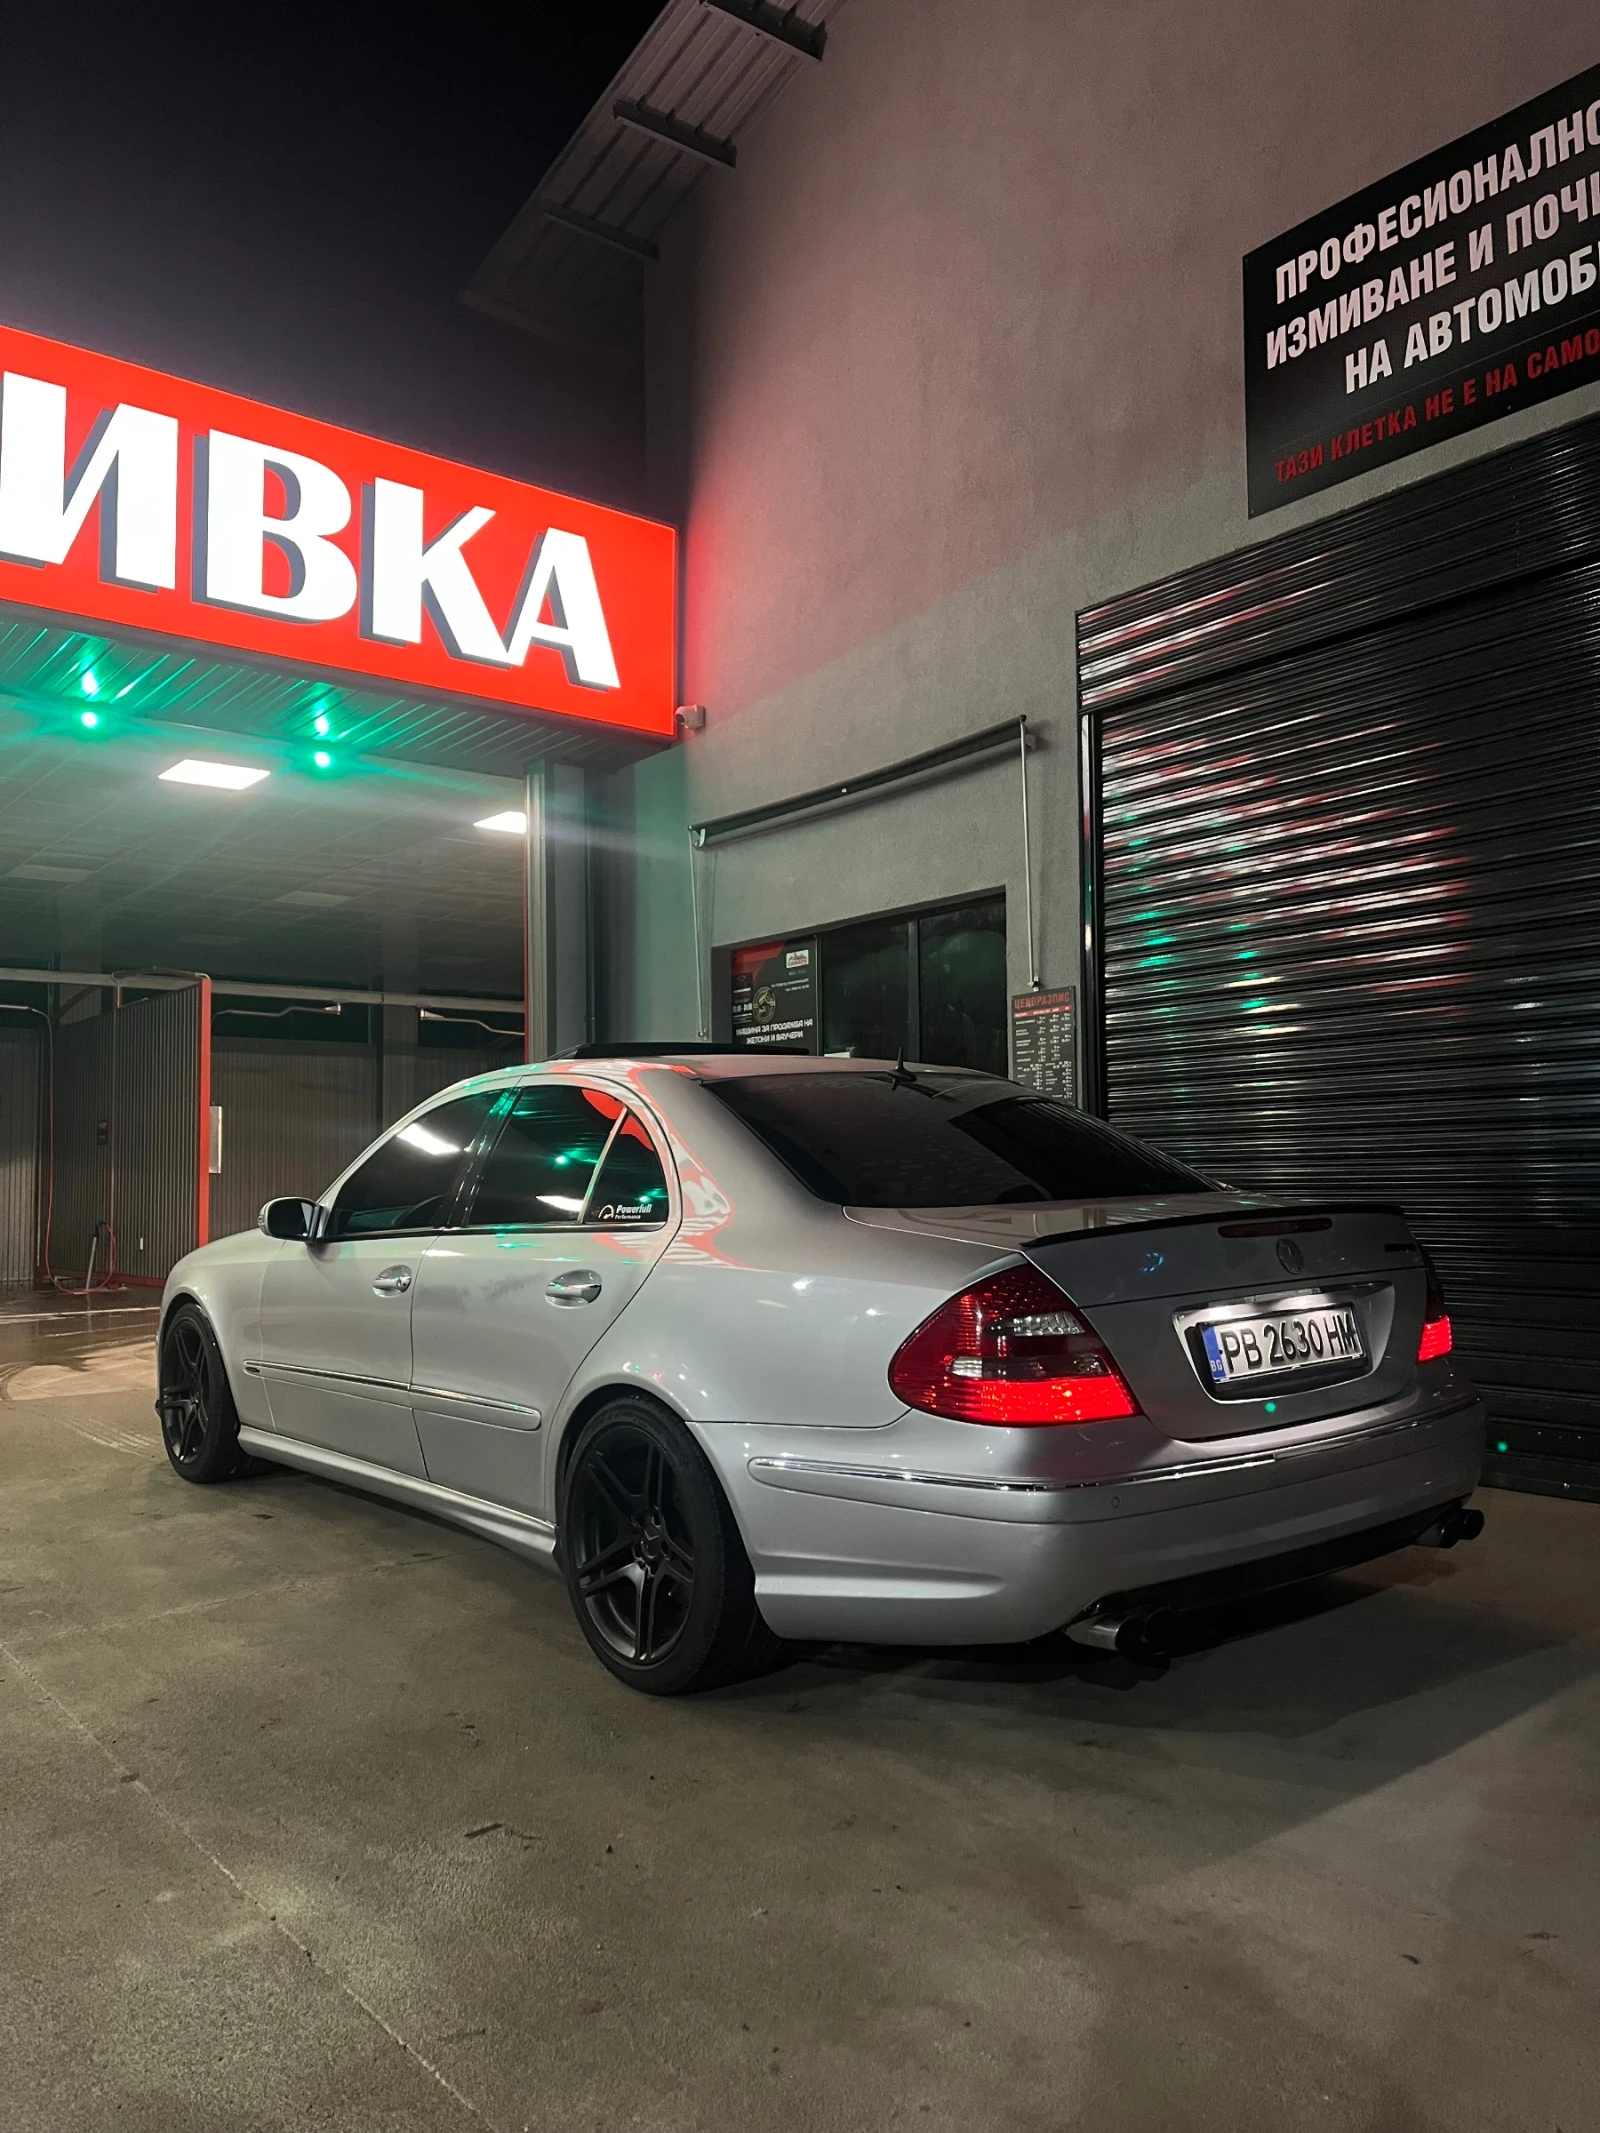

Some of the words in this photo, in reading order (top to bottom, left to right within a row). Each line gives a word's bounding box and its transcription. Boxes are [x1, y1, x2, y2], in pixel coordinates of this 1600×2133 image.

[1266, 241, 1457, 369] ИЗМИВАНЕ
[1468, 223, 1494, 272] И
[1345, 347, 1392, 395] НА
[1403, 241, 1600, 369] АВТОМОБ
[1274, 444, 1324, 484] ТАЗИ
[1331, 405, 1417, 459] КЛЕТКА
[1426, 388, 1454, 422] НЕ
[1463, 378, 1477, 405] Е
[1486, 362, 1518, 397] НА
[0, 370, 621, 690] ИВКА
[1014, 992, 1070, 1010] ЦЕНОРАЗПИС
[736, 1025, 761, 1036] МАШИНА
[762, 1024, 770, 1033] ЗА
[770, 1020, 804, 1031] ПРОДАЖБА
[804, 1018, 813, 1026] НА
[746, 1034, 770, 1045] ЖЕТОНИ
[770, 1034, 775, 1042] И
[776, 1030, 804, 1042] ВАУЧЕРИ
[616, 1204, 652, 1214] Powerfull
[1220, 1327, 1263, 1374] PB
[1263, 1318, 1324, 1366] 2630
[1210, 1359, 1223, 1371] BG
